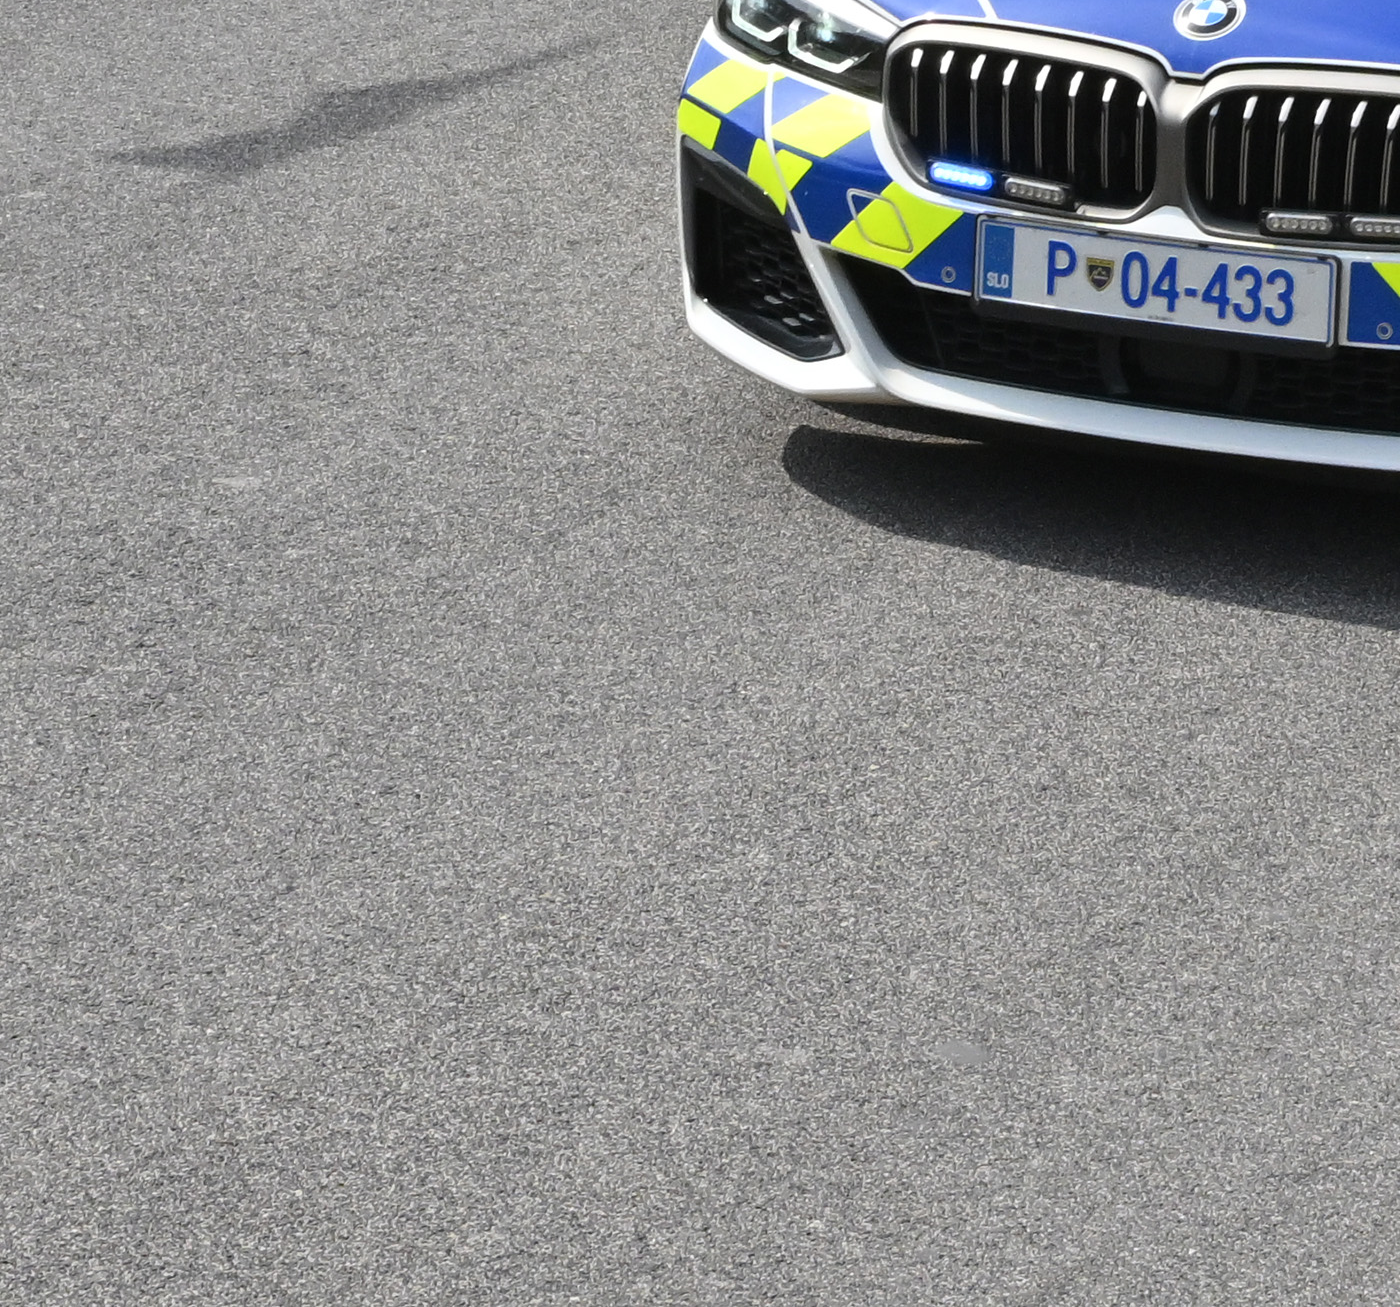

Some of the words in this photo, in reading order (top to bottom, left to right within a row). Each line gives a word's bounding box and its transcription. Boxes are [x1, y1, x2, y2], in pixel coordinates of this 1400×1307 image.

[986, 271, 1009, 289] SLO
[1047, 240, 1077, 296] P
[1121, 251, 1295, 326] 04-433
